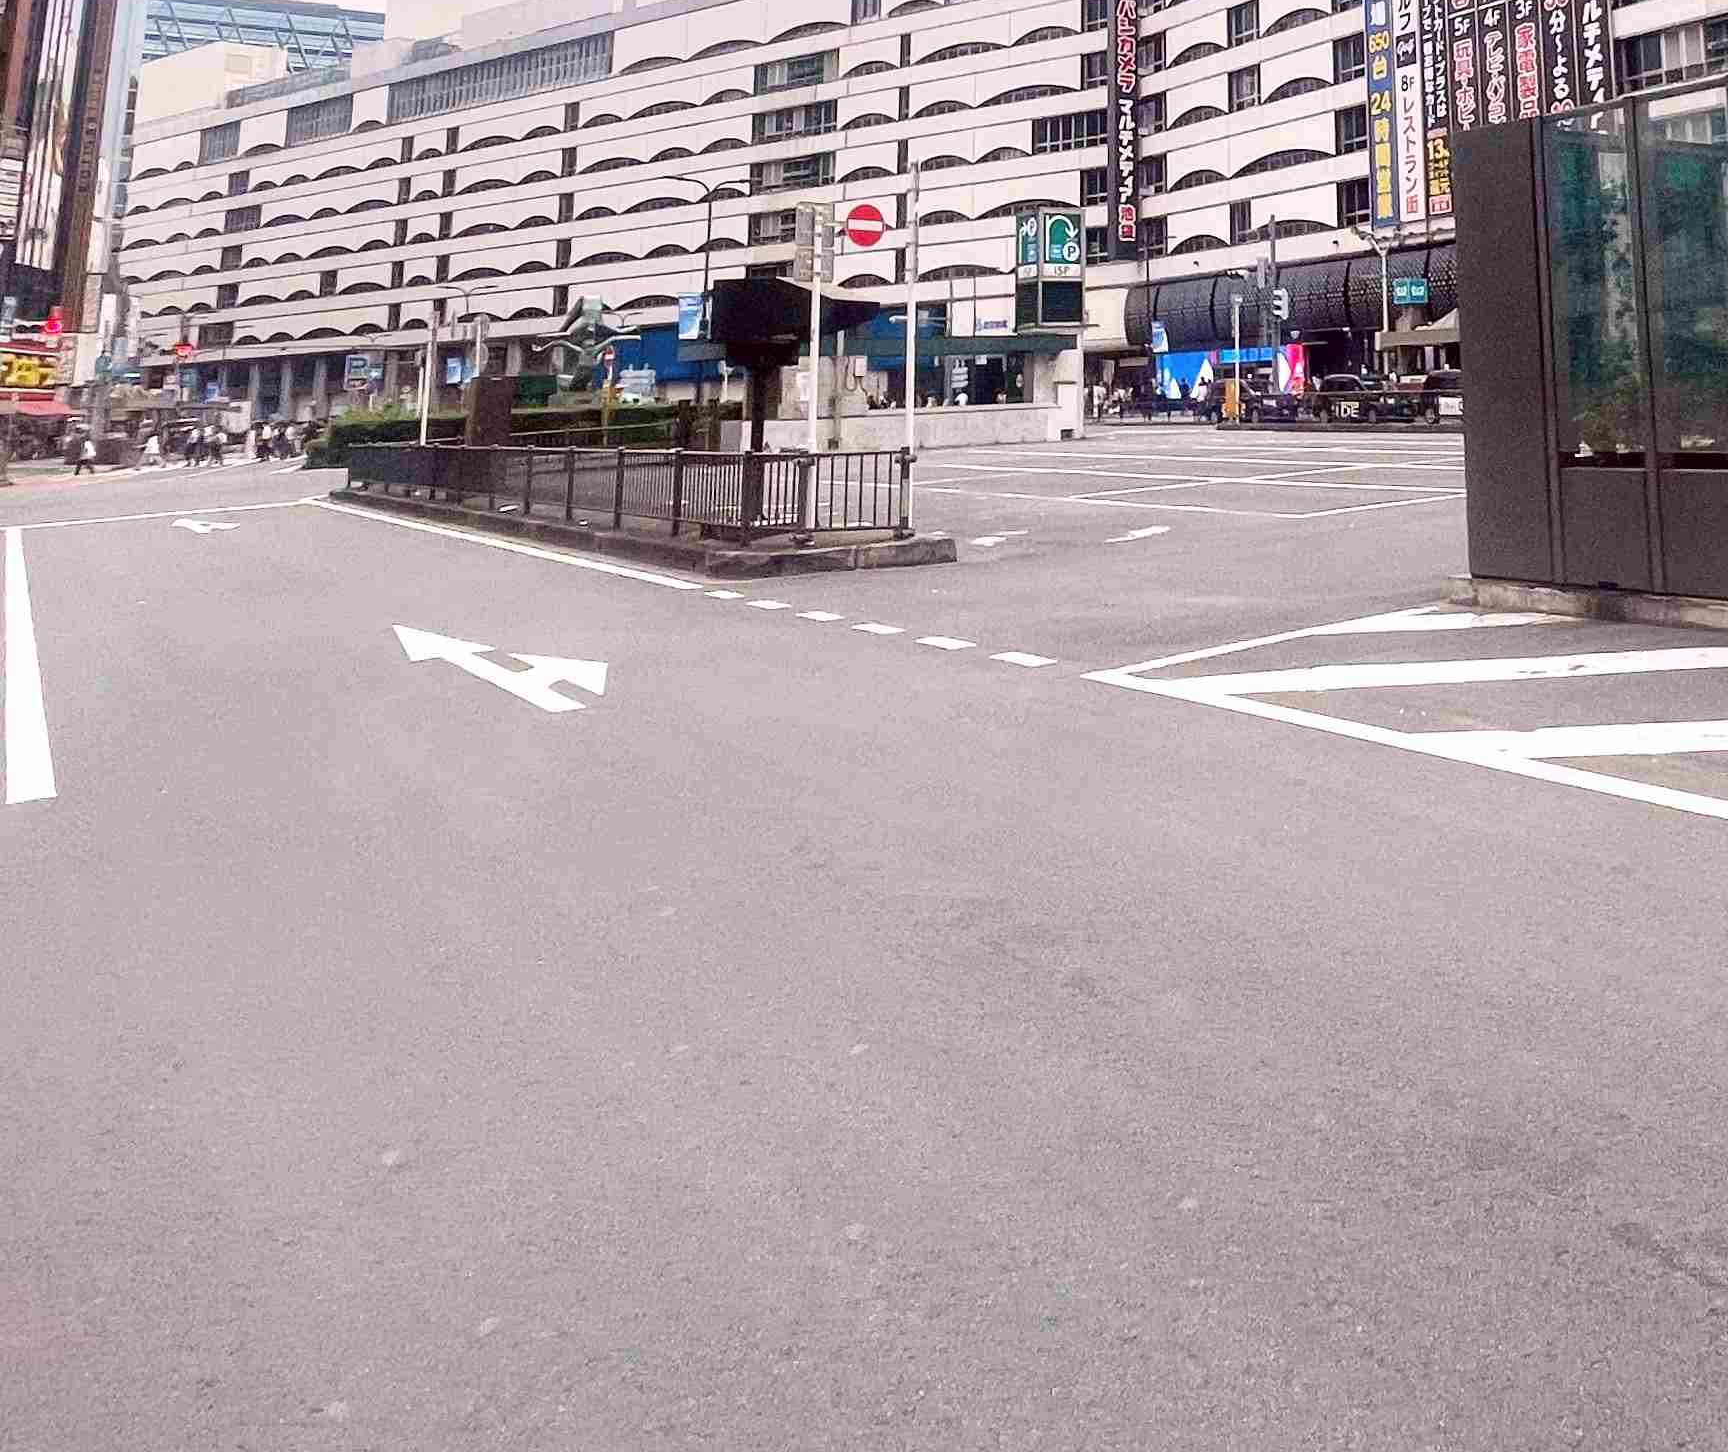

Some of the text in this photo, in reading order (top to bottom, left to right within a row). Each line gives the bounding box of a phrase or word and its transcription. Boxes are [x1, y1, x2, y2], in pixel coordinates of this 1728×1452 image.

[1484, 8, 1501, 27] 4F
[1515, 0, 1533, 20] 3F
[1454, 16, 1471, 36] 5F
[1401, 75, 1416, 92] 8F
[1118, 98, 1136, 203] マルチメディア
